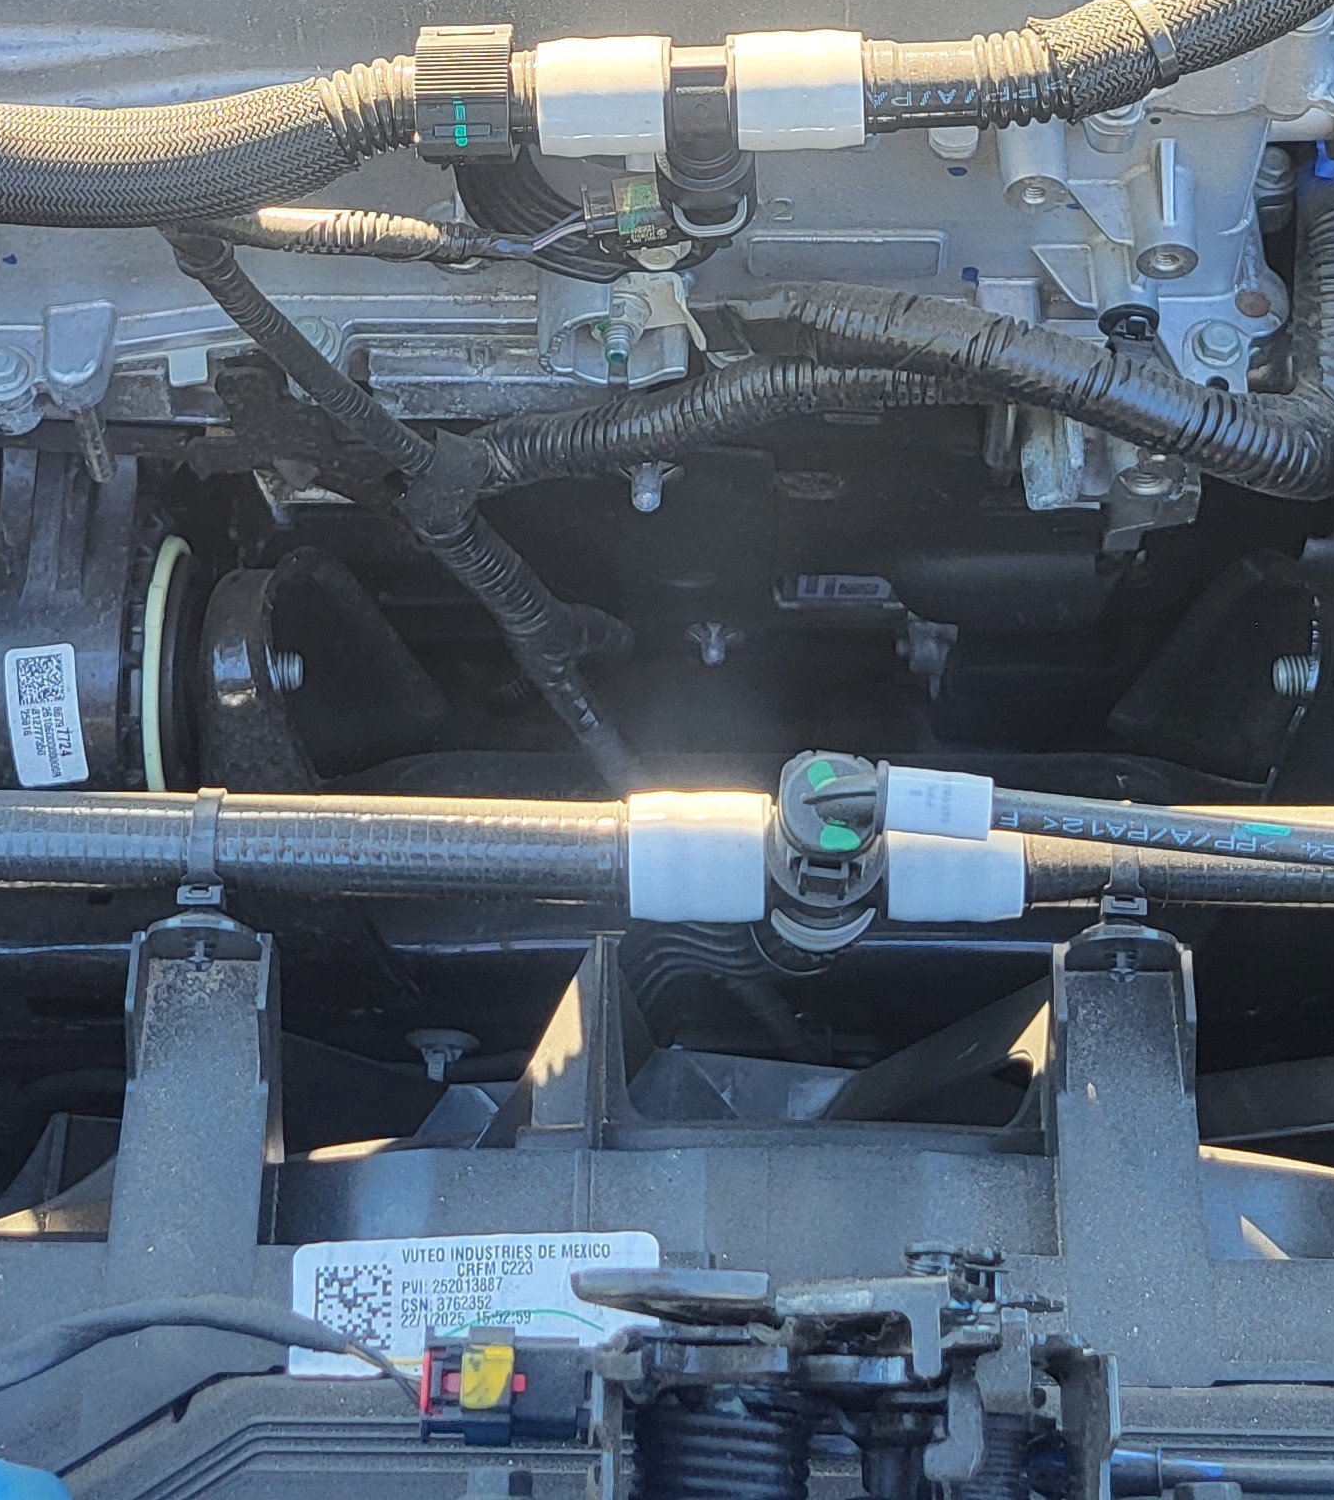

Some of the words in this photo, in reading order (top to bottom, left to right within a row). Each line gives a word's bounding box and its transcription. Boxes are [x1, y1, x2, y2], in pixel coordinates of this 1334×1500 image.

[402, 1248, 446, 1264] VUTEO
[450, 1245, 533, 1262] INDUSTRIES
[538, 1244, 557, 1260] DE
[561, 1243, 611, 1259] MEXICO
[457, 1262, 496, 1277] CRFM
[501, 1260, 534, 1276] C223
[432, 1277, 504, 1293] 252013887
[401, 1297, 432, 1312] CSN:
[437, 1295, 493, 1311] 3762352
